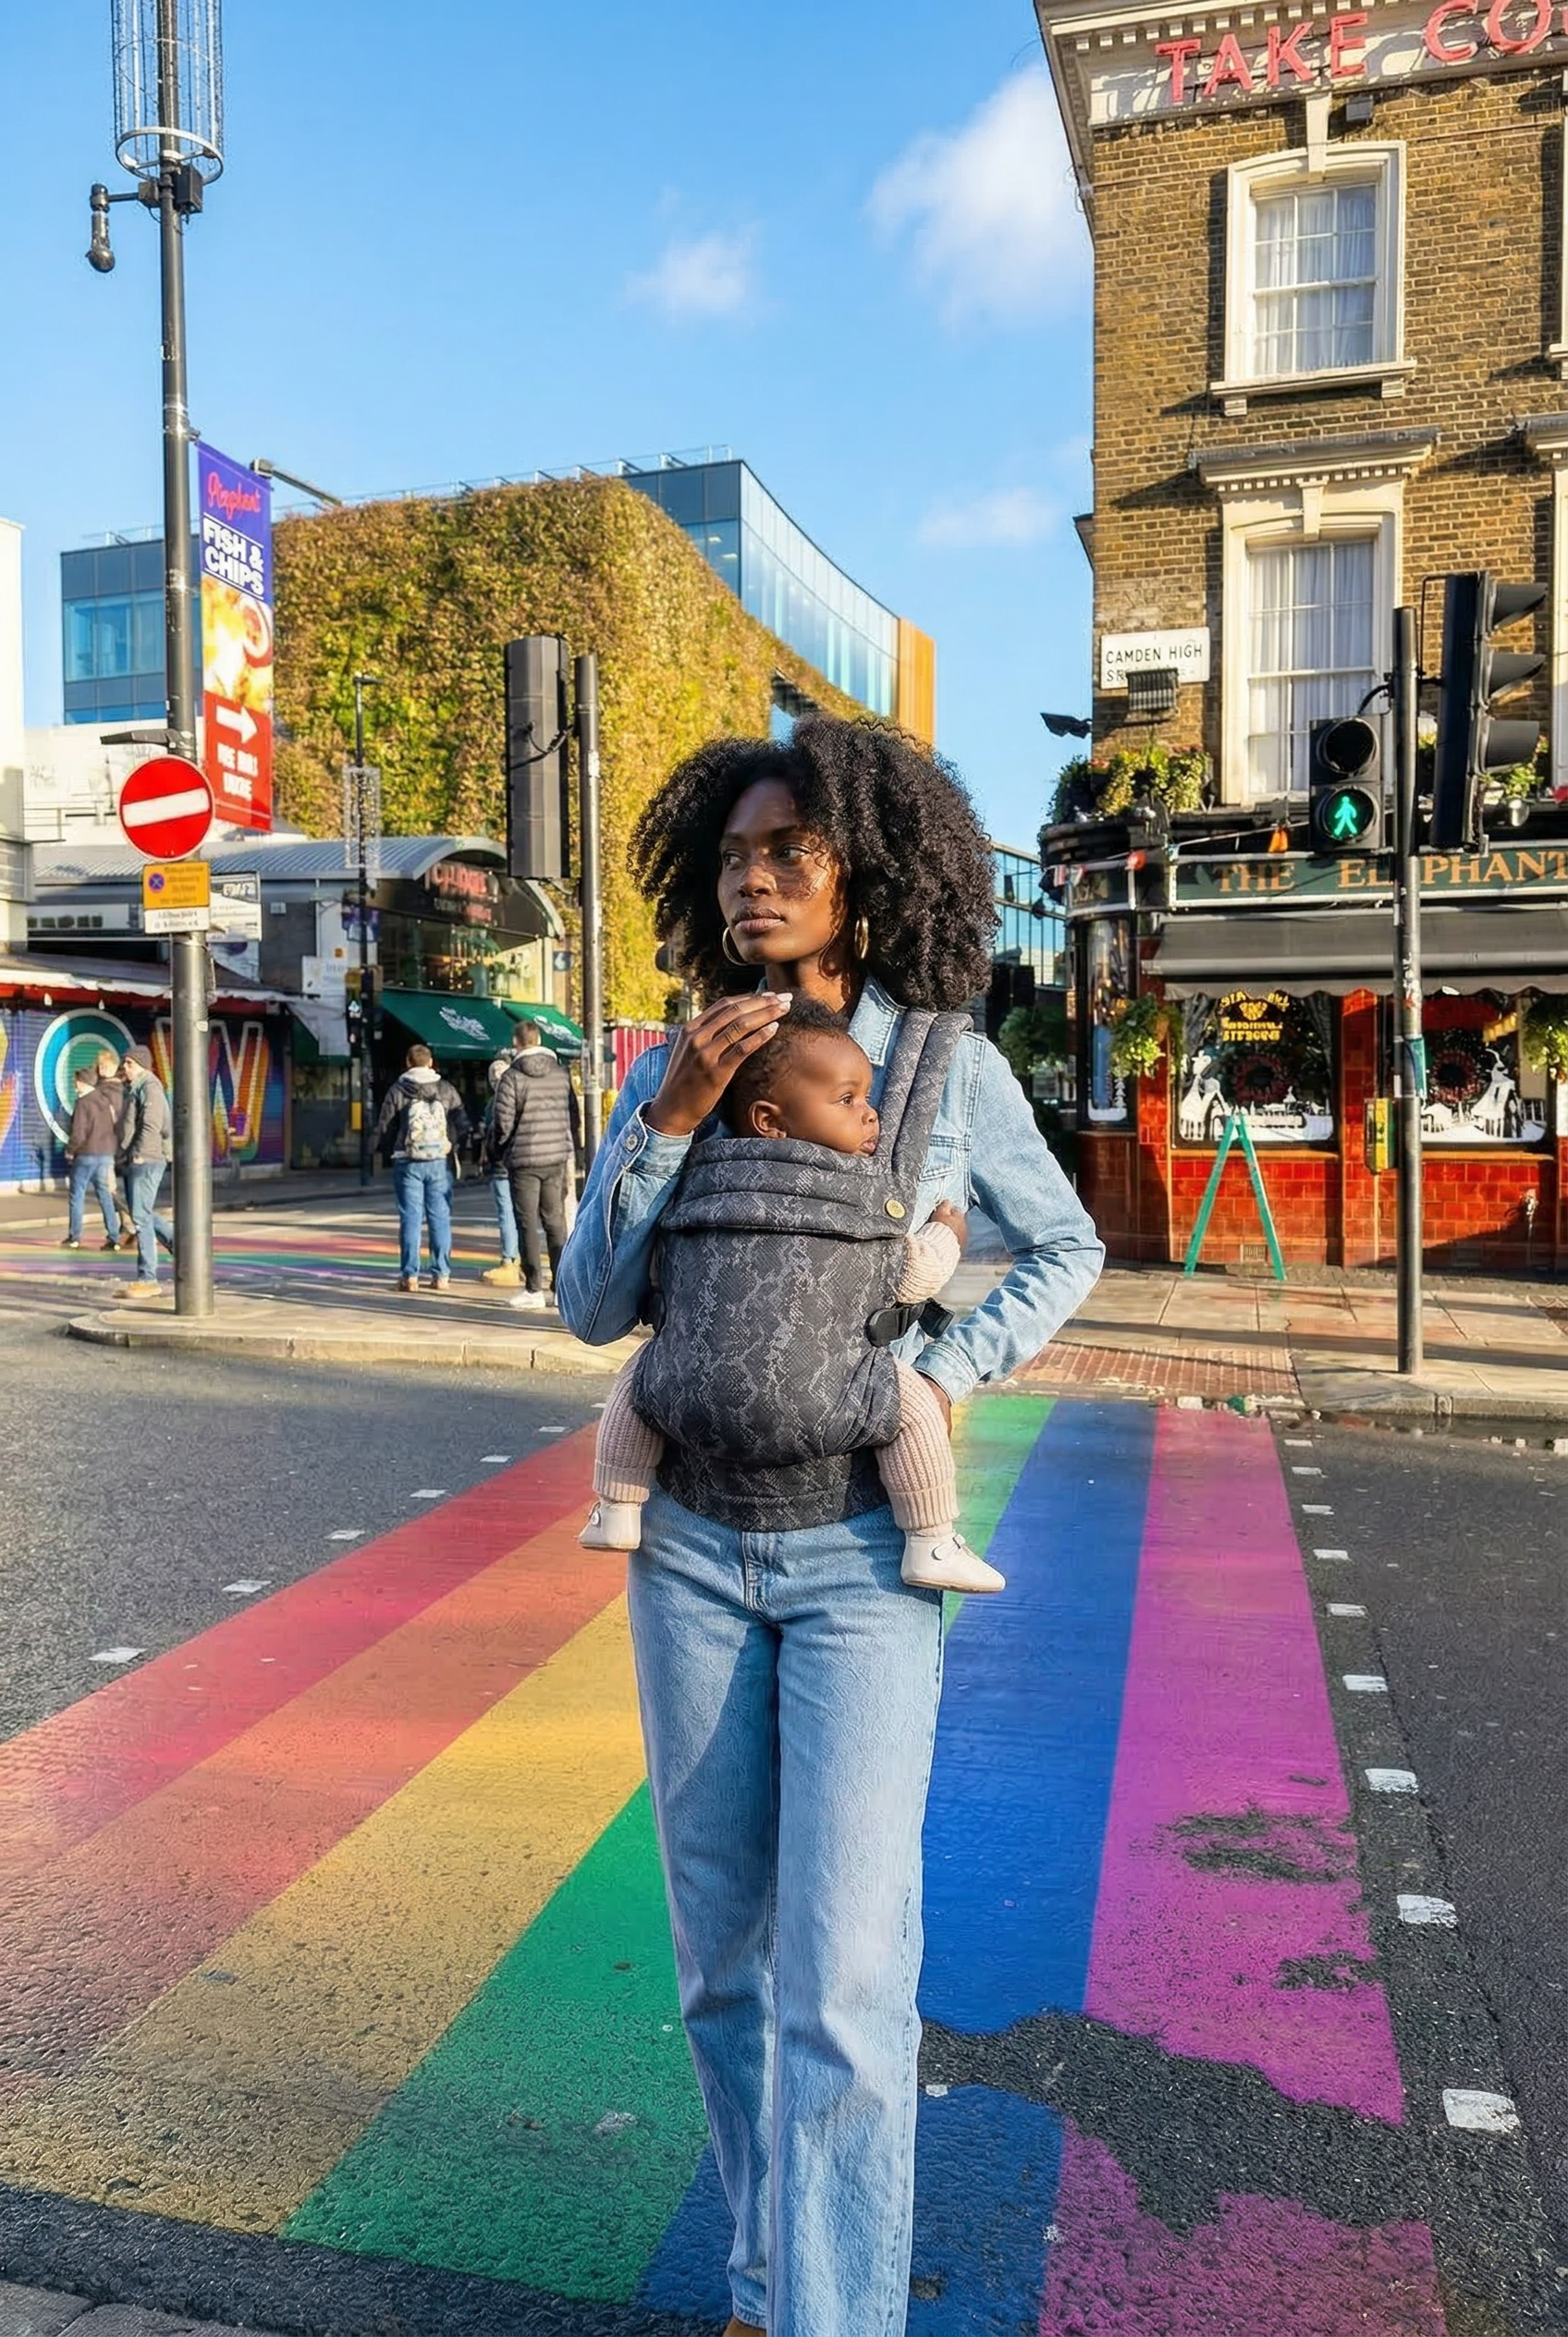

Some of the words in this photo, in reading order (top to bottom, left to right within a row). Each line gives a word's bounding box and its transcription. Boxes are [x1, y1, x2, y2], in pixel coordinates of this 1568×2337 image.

[1155, 11, 1368, 104] TAKE
[1424, 0, 1568, 63] CO
[202, 517, 247, 563] FISH
[249, 544, 264, 573] &
[204, 545, 264, 595] CHIPS
[1106, 647, 1162, 665] CAMDEN
[1169, 643, 1203, 660] HIGH
[1213, 862, 1295, 893] THE
[1336, 850, 1568, 887] ELPHANT
